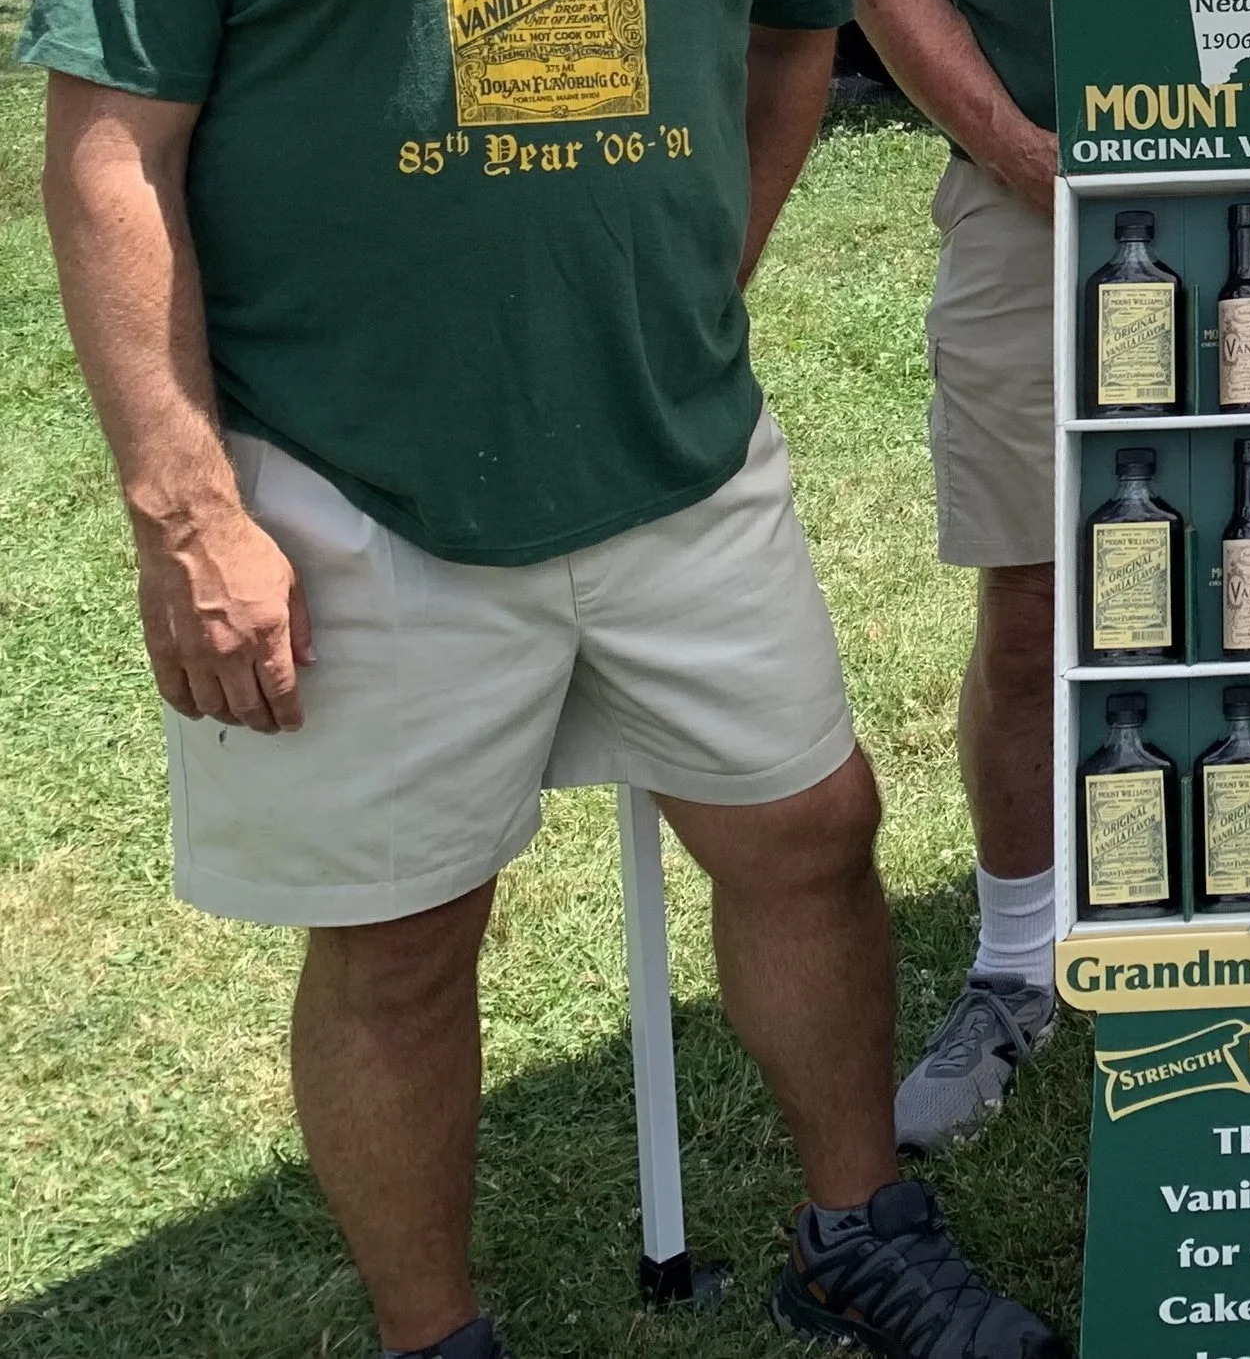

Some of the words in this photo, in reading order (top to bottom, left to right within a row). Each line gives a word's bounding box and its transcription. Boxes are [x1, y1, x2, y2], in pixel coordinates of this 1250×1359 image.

[551, 15, 567, 24] OF
[567, 13, 608, 23] FLAVOR
[555, 4, 586, 13] DROP
[588, 4, 597, 12] A
[498, 33, 526, 43] WILL
[530, 32, 550, 42] NOT
[554, 31, 583, 40] COOK
[585, 30, 606, 39] OUT
[480, 78, 530, 98] DOLAN
[532, 72, 607, 93] FLAVORING
[556, 94, 580, 102] MAINE
[1084, 83, 1243, 132] MOUNT
[399, 130, 469, 175] 85th
[484, 134, 583, 176] Year
[1072, 135, 1231, 163] ORIGINAL
[1106, 338, 1136, 358] VANILLA
[1137, 323, 1166, 344] FLAVOR
[1114, 314, 1157, 341] ORIGINAL
[1101, 580, 1131, 600] VANILLA
[1133, 563, 1161, 586] FLAVOR
[1109, 554, 1152, 583] ORIGINAL
[1095, 832, 1126, 854] VANILLA
[1127, 814, 1156, 838] FLAVOR
[1103, 805, 1147, 837] ORIGINAL
[1212, 823, 1243, 844] VANILLA
[1118, 1048, 1222, 1091] STRENGTH
[1177, 1238, 1240, 1269] for
